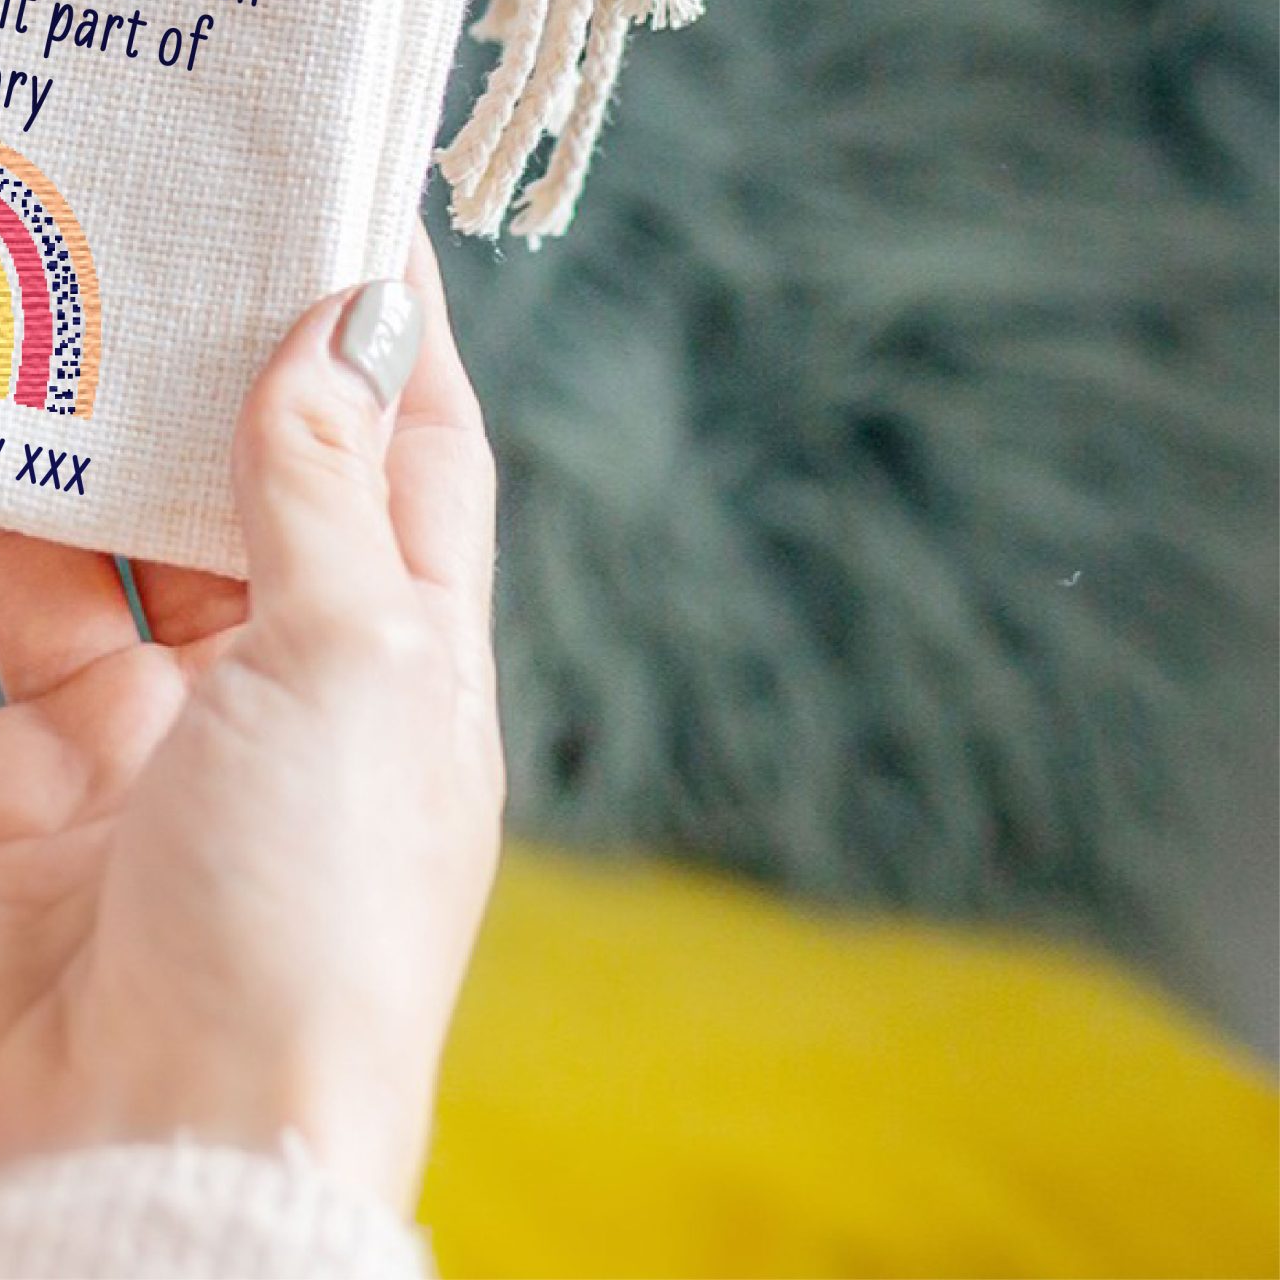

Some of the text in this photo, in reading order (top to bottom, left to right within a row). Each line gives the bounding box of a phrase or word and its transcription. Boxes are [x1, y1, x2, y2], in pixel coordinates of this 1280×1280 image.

[43, 1, 148, 59] part
[158, 13, 215, 72] of
[15, 443, 92, 496] xxx
